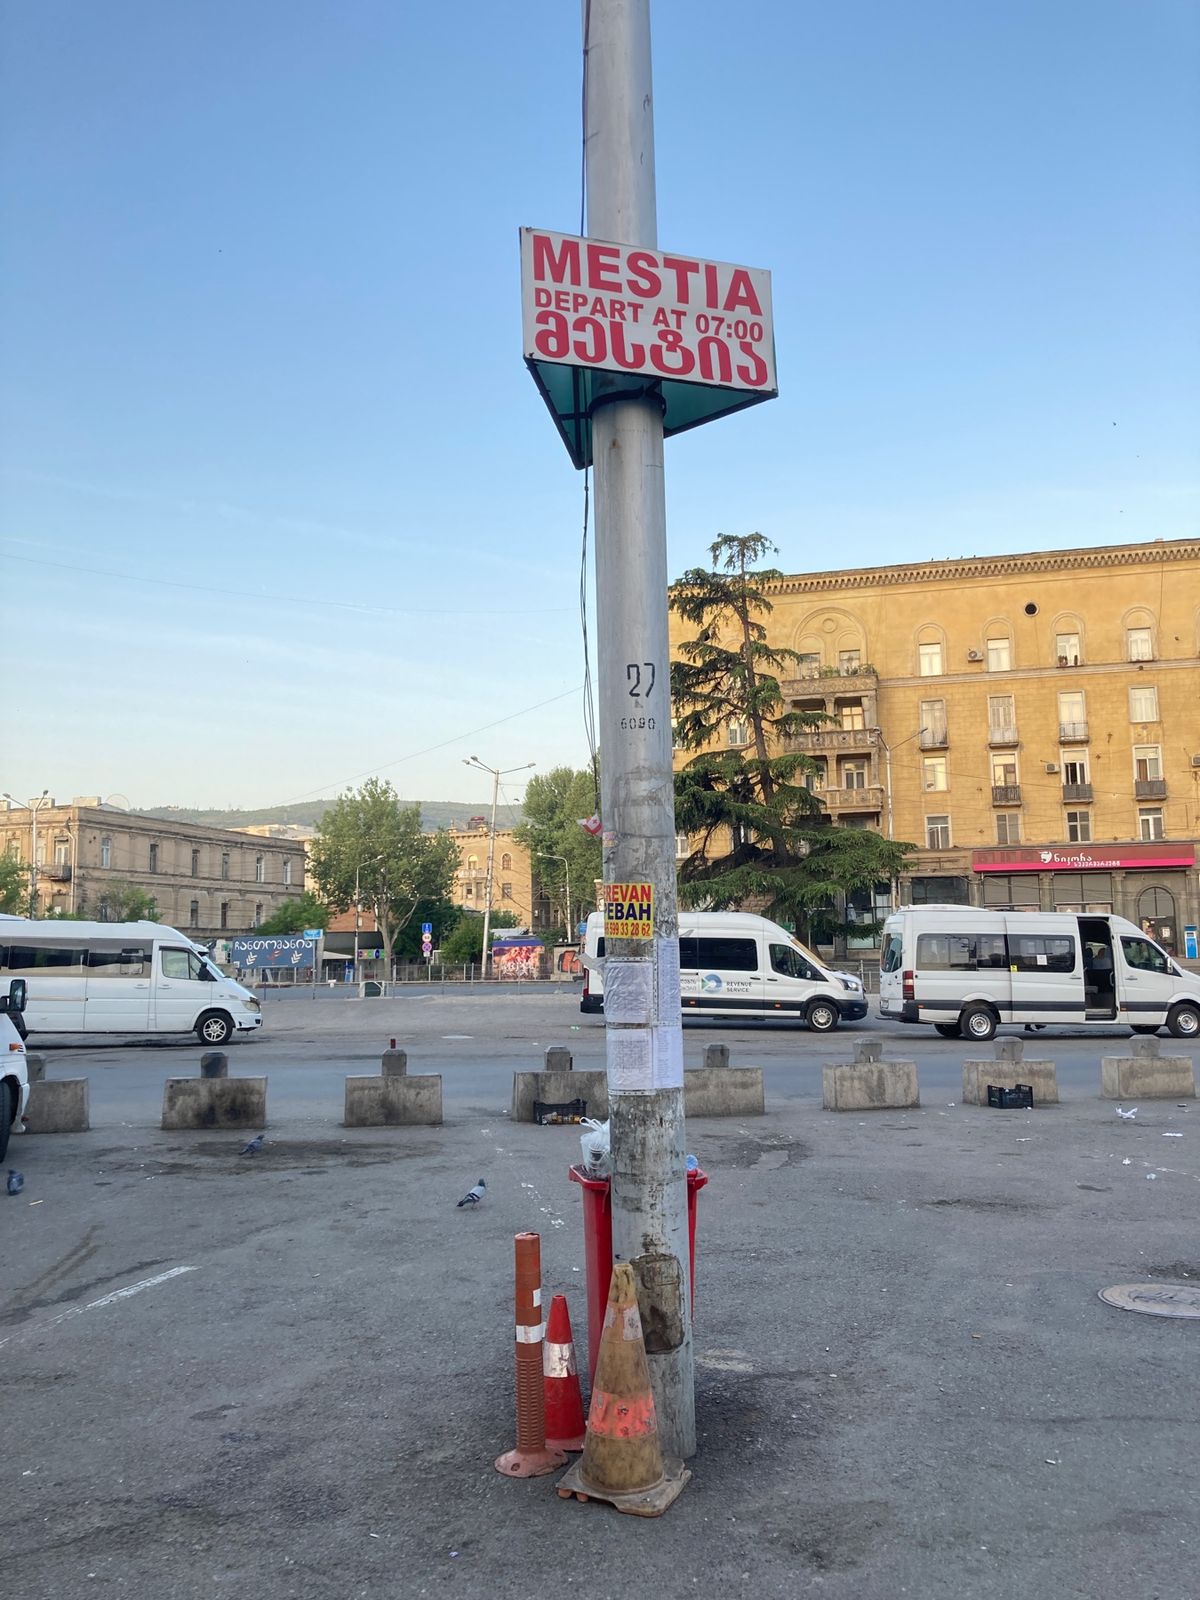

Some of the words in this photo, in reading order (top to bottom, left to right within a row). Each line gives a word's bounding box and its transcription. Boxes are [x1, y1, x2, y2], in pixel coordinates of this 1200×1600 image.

[532, 234, 763, 316] MESTIA
[534, 287, 644, 323] DEPART
[652, 307, 687, 330] AT
[695, 313, 763, 342] 07:00
[534, 310, 768, 387] მესტია
[626, 662, 656, 698] 27
[620, 922, 628, 936] 33
[630, 922, 640, 936] 28
[641, 922, 651, 937] 62
